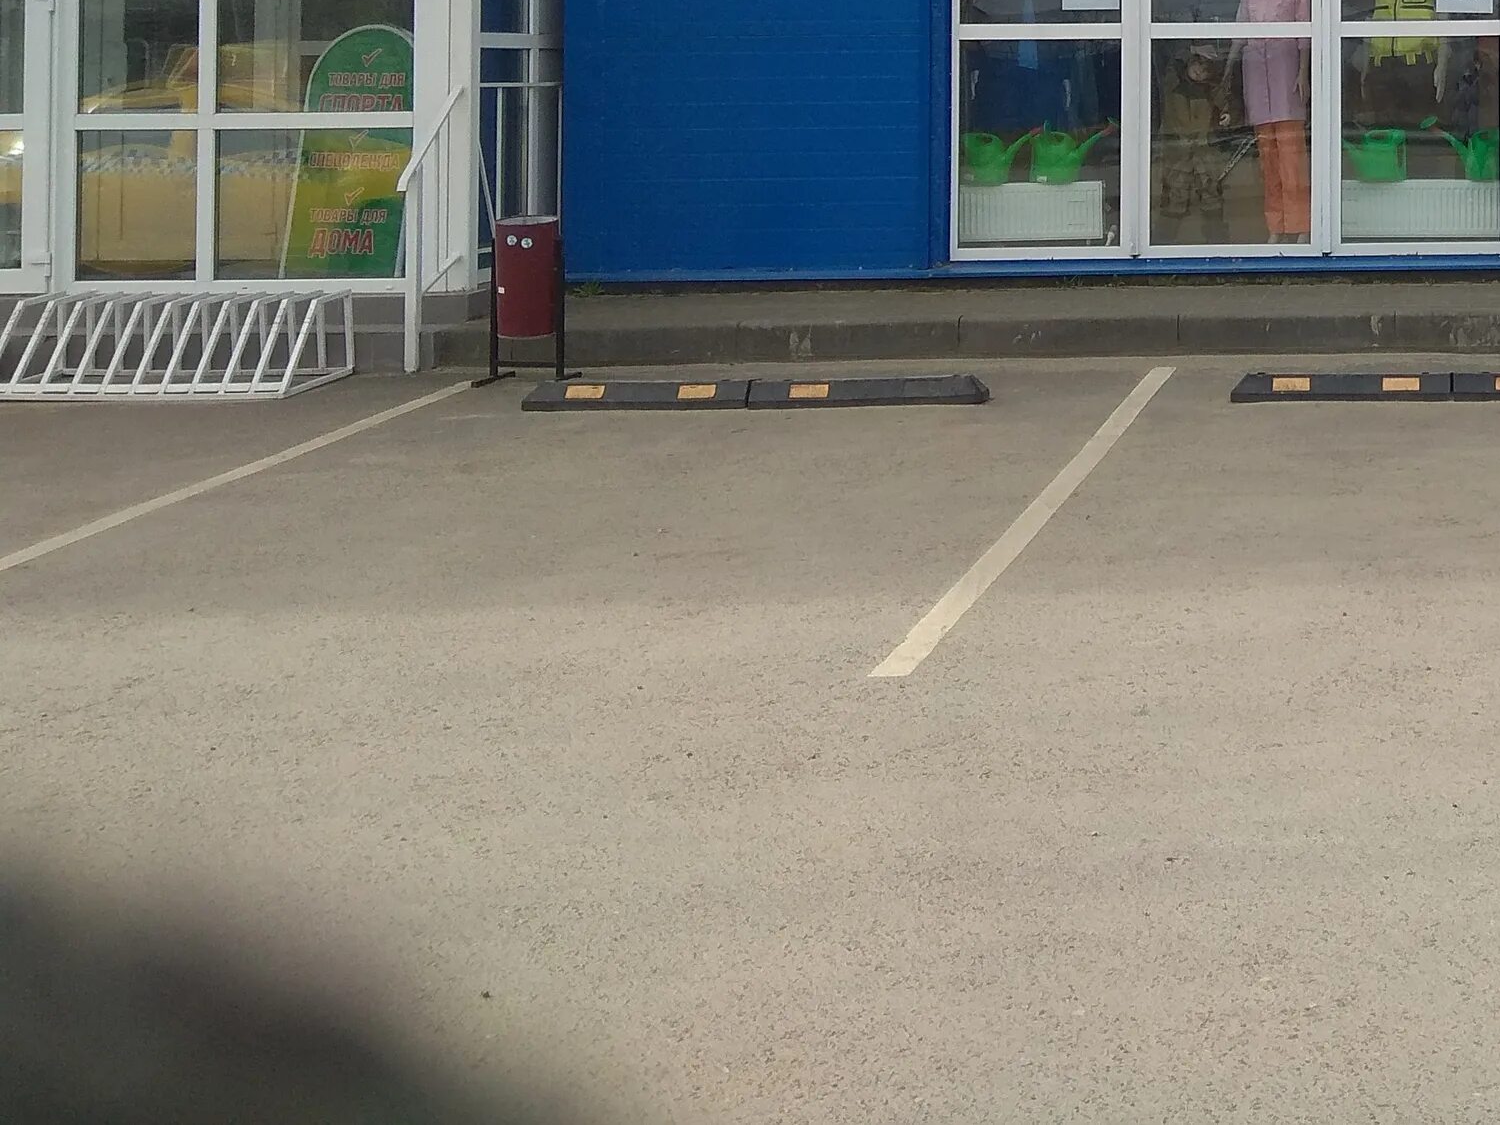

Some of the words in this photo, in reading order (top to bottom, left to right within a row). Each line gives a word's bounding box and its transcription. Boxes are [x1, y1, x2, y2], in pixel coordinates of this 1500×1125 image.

[327, 72, 378, 87] ТОВАРЫ
[378, 72, 406, 89] ДЛЯ
[309, 208, 361, 223] ТОВАРЫ
[360, 208, 388, 225] ДЛЯ
[307, 227, 375, 259] ДОМА
